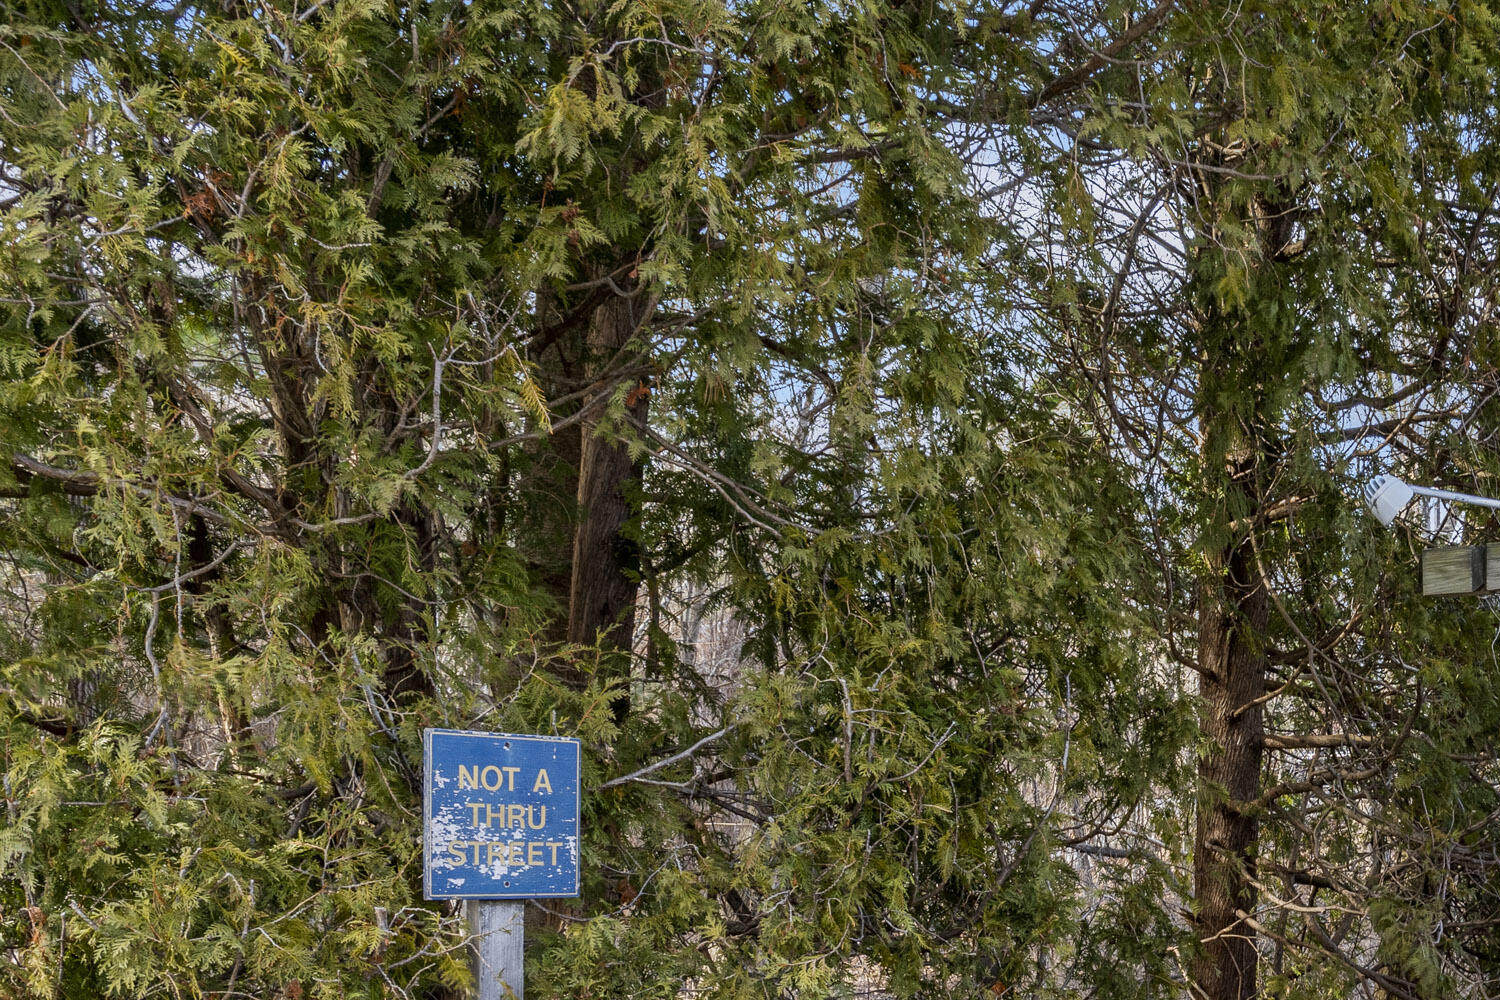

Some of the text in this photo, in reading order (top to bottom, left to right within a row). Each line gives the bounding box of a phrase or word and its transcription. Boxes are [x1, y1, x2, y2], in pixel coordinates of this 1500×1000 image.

[458, 764, 553, 793] NOT A
[466, 802, 546, 830] THRU
[447, 840, 564, 867] STREET
